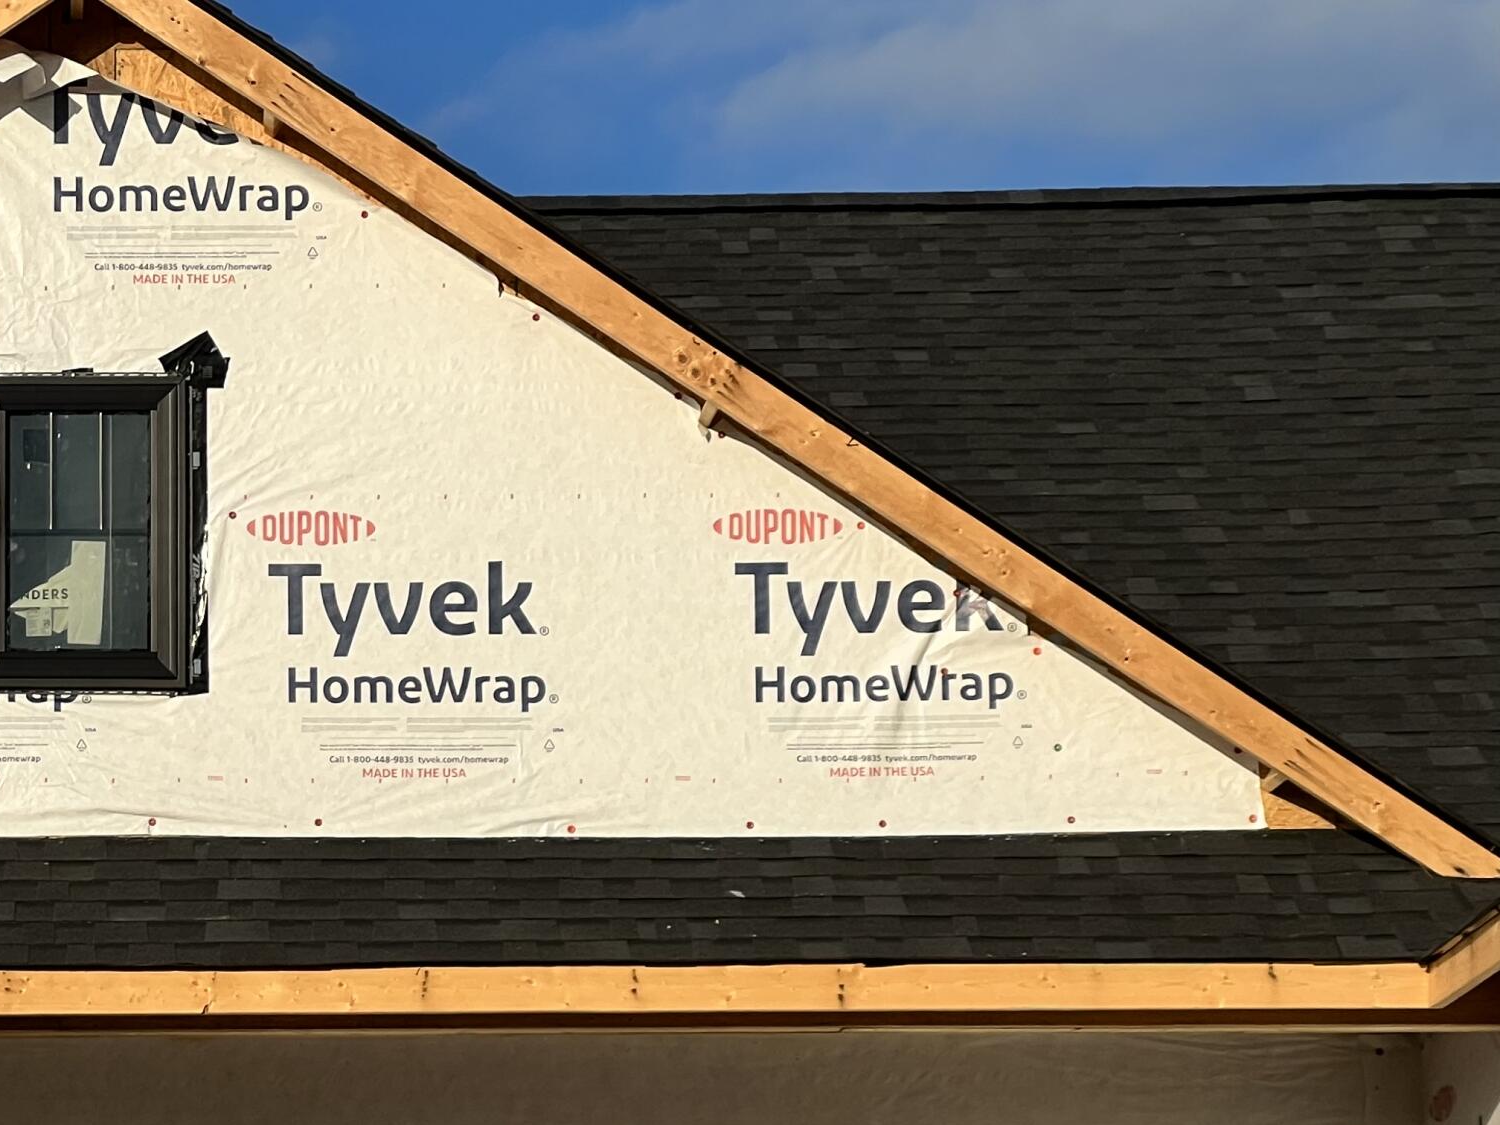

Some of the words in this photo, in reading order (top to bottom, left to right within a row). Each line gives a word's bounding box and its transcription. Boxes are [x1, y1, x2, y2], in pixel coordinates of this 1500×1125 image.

[53, 80, 262, 166] Tyv
[53, 176, 309, 220] HomeWrap
[94, 263, 109, 271] Call
[112, 263, 178, 271] 1-800-448-9835
[133, 274, 167, 284] MADE
[172, 274, 183, 284] IN
[187, 274, 209, 284] THE
[212, 274, 236, 284] USA
[262, 510, 362, 546] DUPONT
[729, 509, 829, 545] DUPONT
[268, 561, 537, 657] Tyvek
[735, 561, 1004, 656] Tyvek
[288, 667, 546, 712] HomeWrap
[755, 665, 1013, 710] HomeWrap
[329, 756, 344, 764] Call
[362, 768, 398, 779] MADE
[401, 768, 414, 779] IN
[417, 768, 440, 779] THE
[443, 768, 467, 779] USA
[796, 754, 812, 763] Call
[830, 767, 866, 778] MADE
[869, 767, 882, 778] IN
[884, 767, 908, 778] THE
[910, 767, 934, 778] USA
